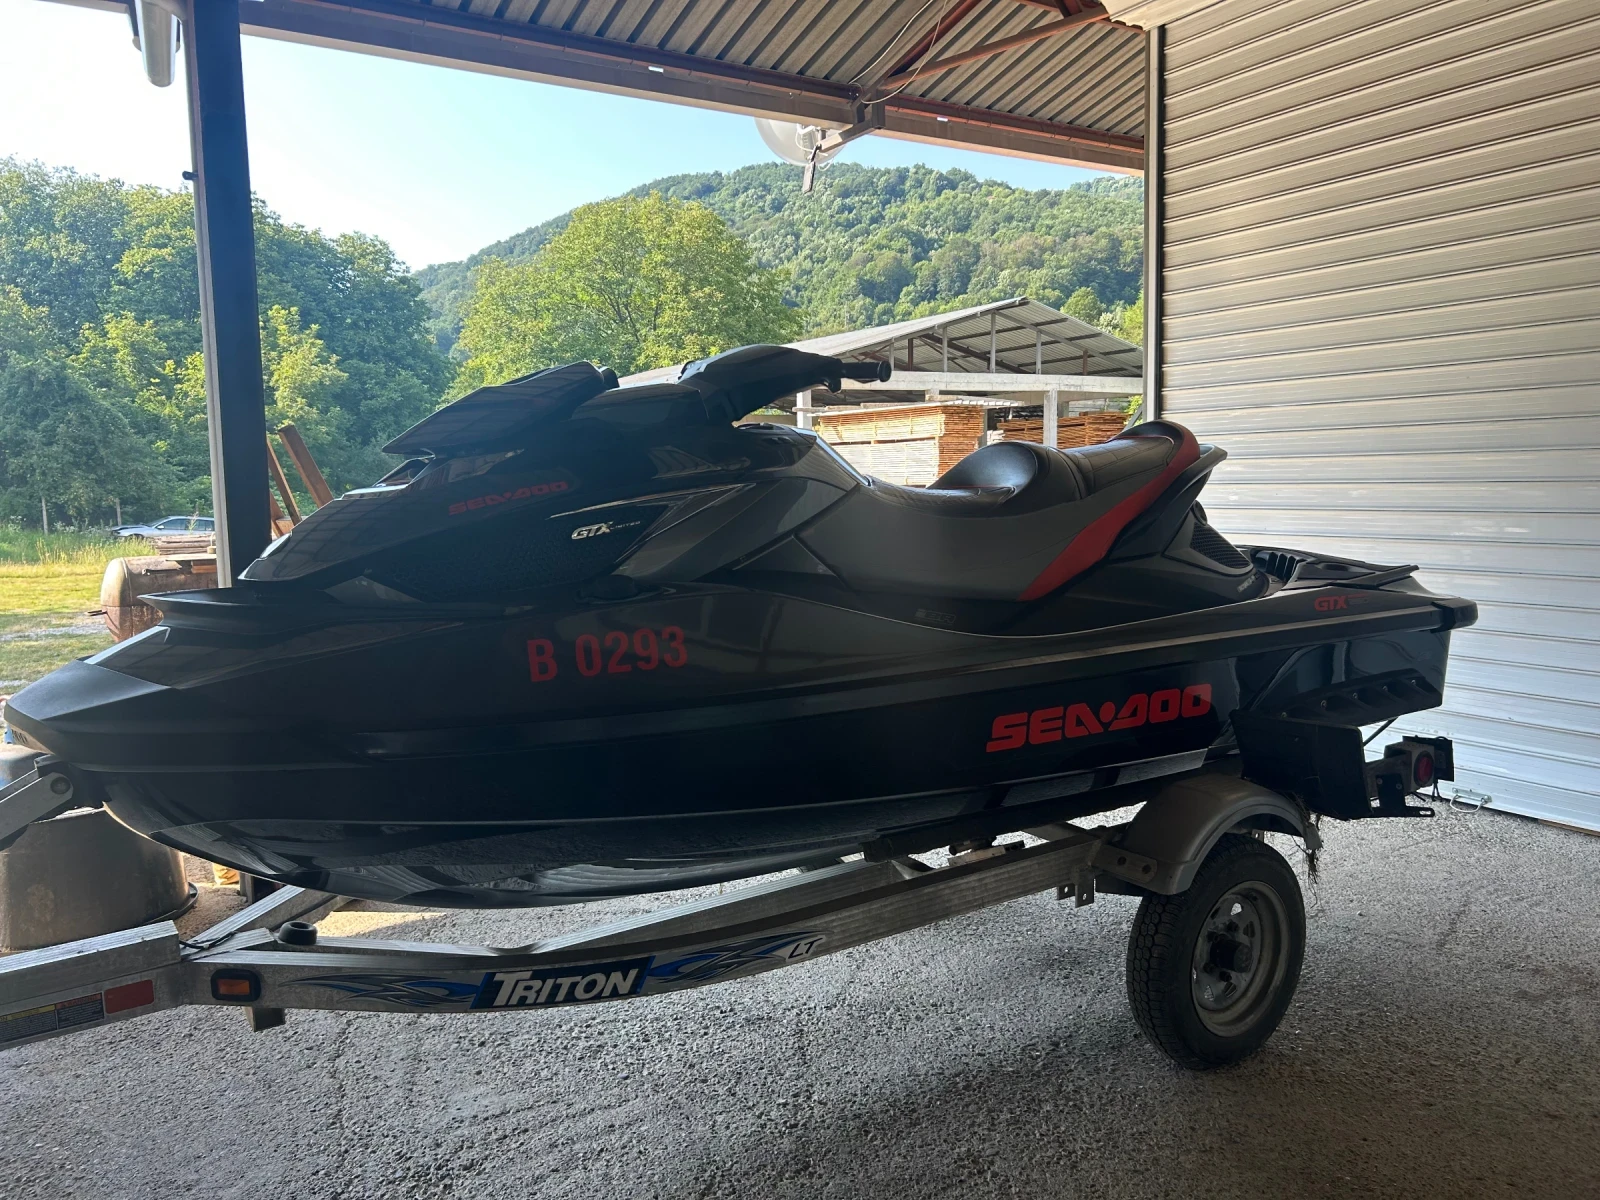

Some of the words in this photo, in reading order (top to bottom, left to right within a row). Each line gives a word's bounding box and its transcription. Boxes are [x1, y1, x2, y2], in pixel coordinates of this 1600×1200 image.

[571, 521, 614, 540] GTX
[1314, 595, 1350, 612] GTX
[527, 638, 558, 682] B
[575, 626, 688, 678] 0293
[787, 937, 823, 960] LT
[492, 968, 638, 1008] TRITON
